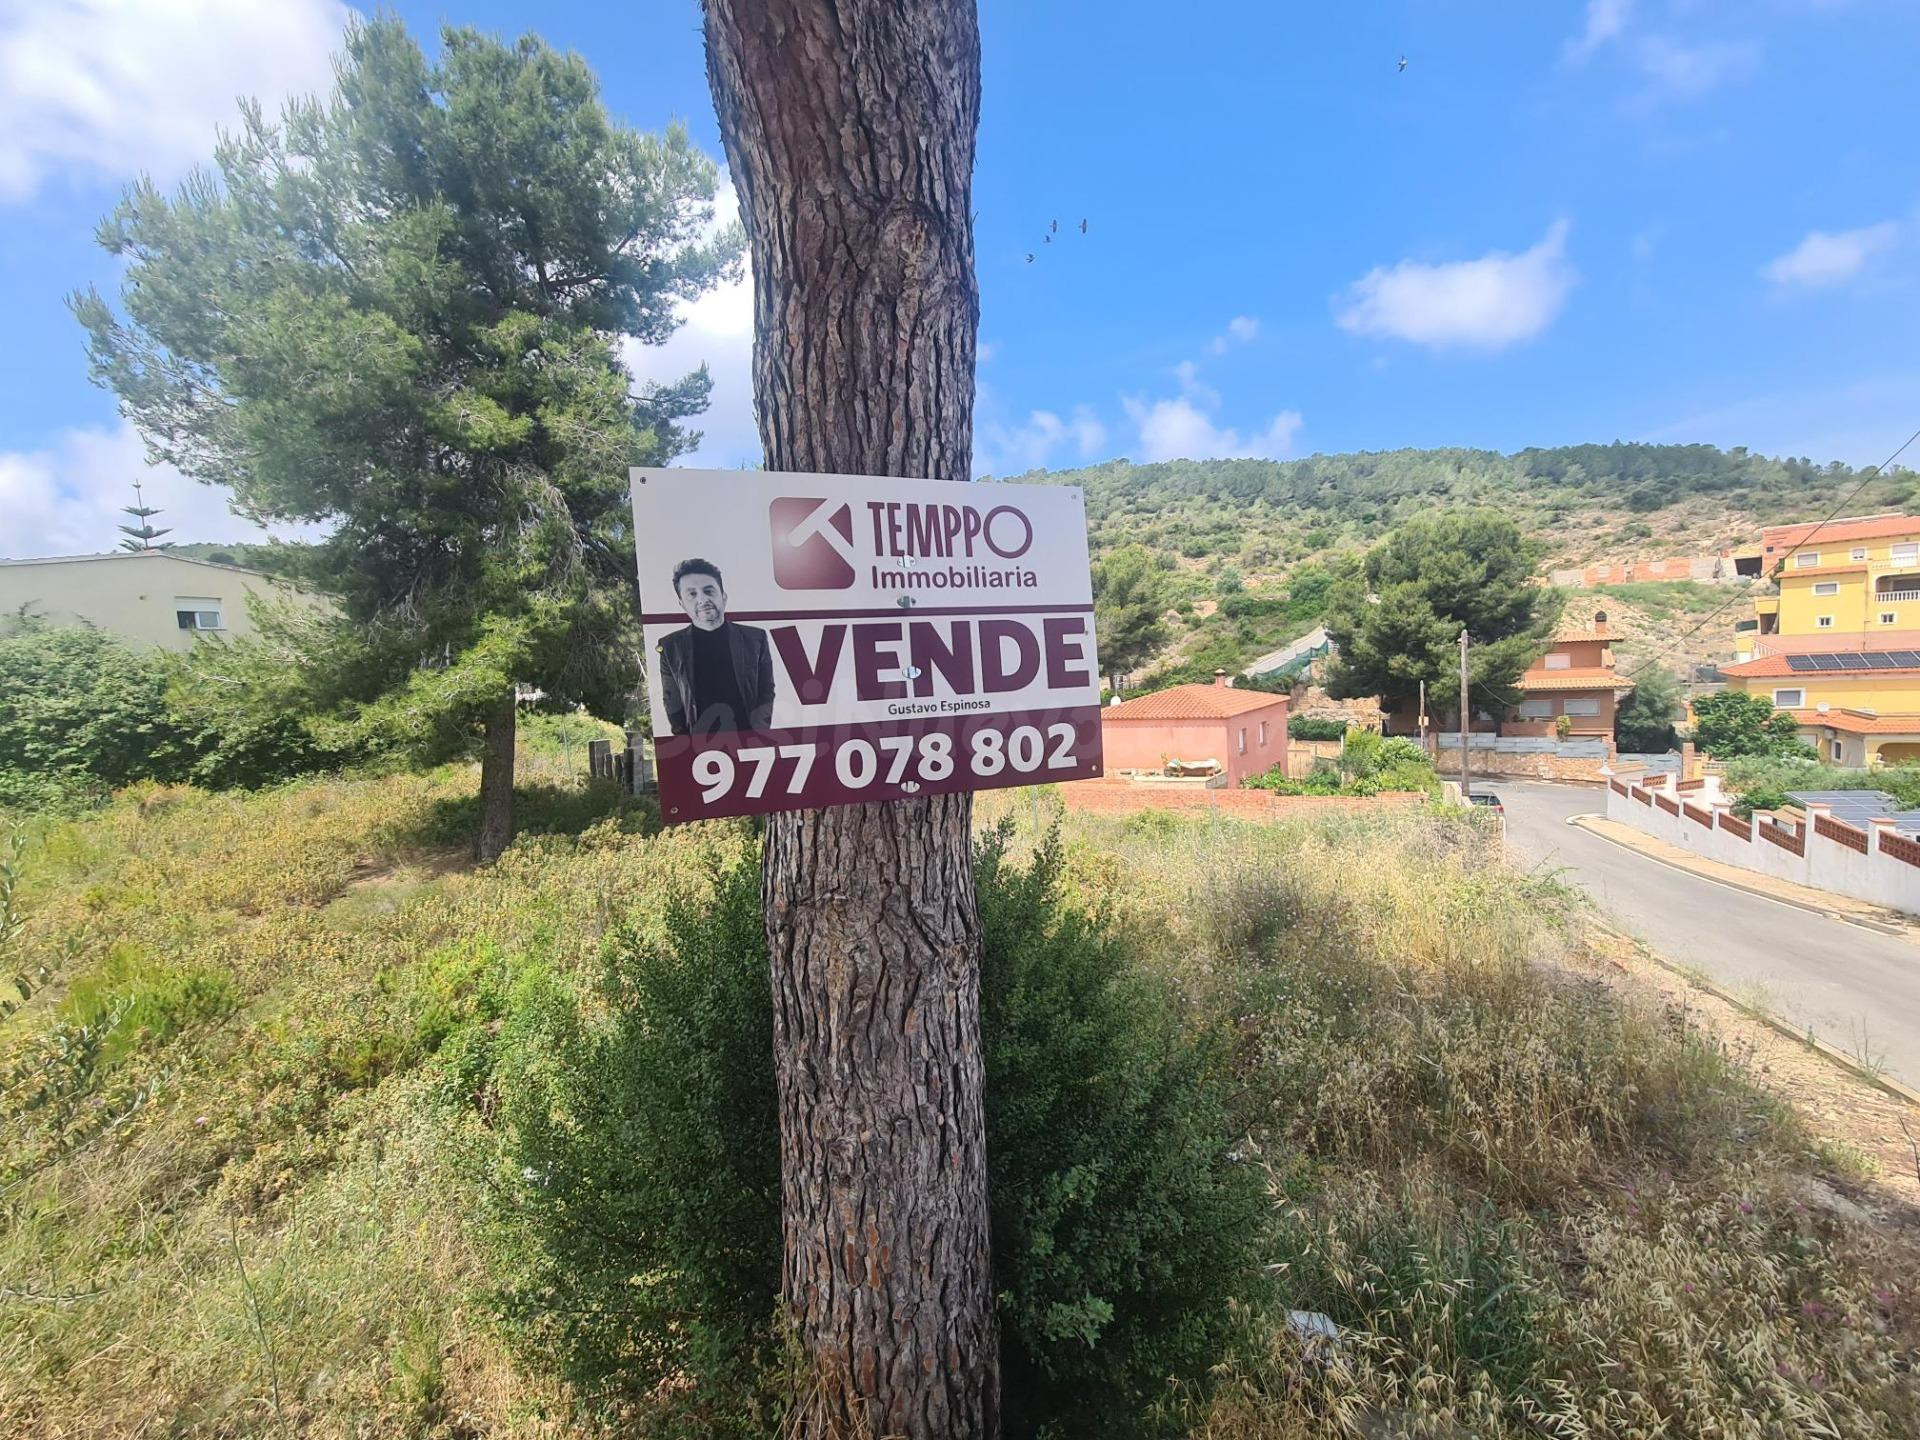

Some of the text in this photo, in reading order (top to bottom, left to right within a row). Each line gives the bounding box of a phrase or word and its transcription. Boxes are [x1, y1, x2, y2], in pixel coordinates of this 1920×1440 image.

[867, 501, 1033, 559] TEMPPO
[872, 566, 1038, 589] Immobiliaria
[770, 618, 1090, 705] VENDE
[888, 699, 991, 716] Gustavo Espinosa
[692, 723, 1078, 804] 977 078 802
